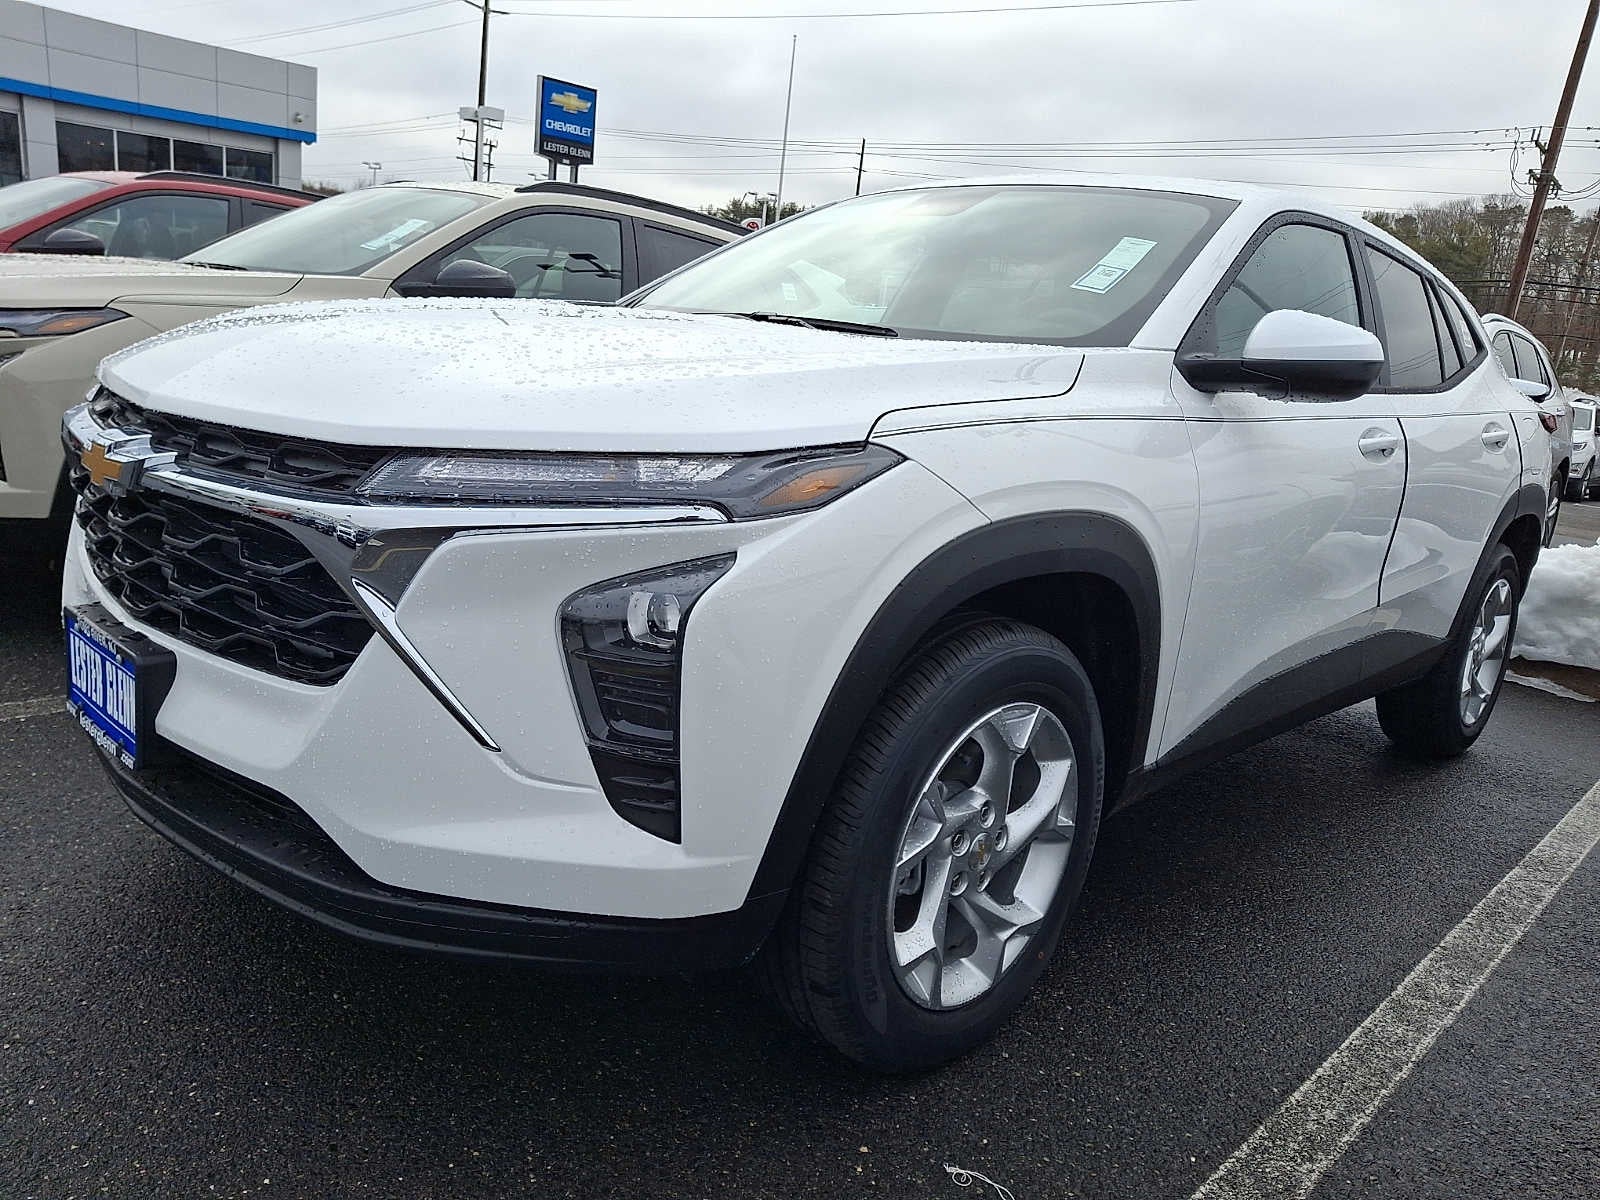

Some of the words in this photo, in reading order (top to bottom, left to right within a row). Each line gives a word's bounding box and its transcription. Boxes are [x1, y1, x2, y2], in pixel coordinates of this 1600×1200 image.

[545, 119, 592, 137] CHEVROLET
[543, 141, 569, 155] LESTER
[570, 147, 591, 159] GLENN
[70, 633, 103, 708] LESTER
[106, 660, 136, 736] GLENN
